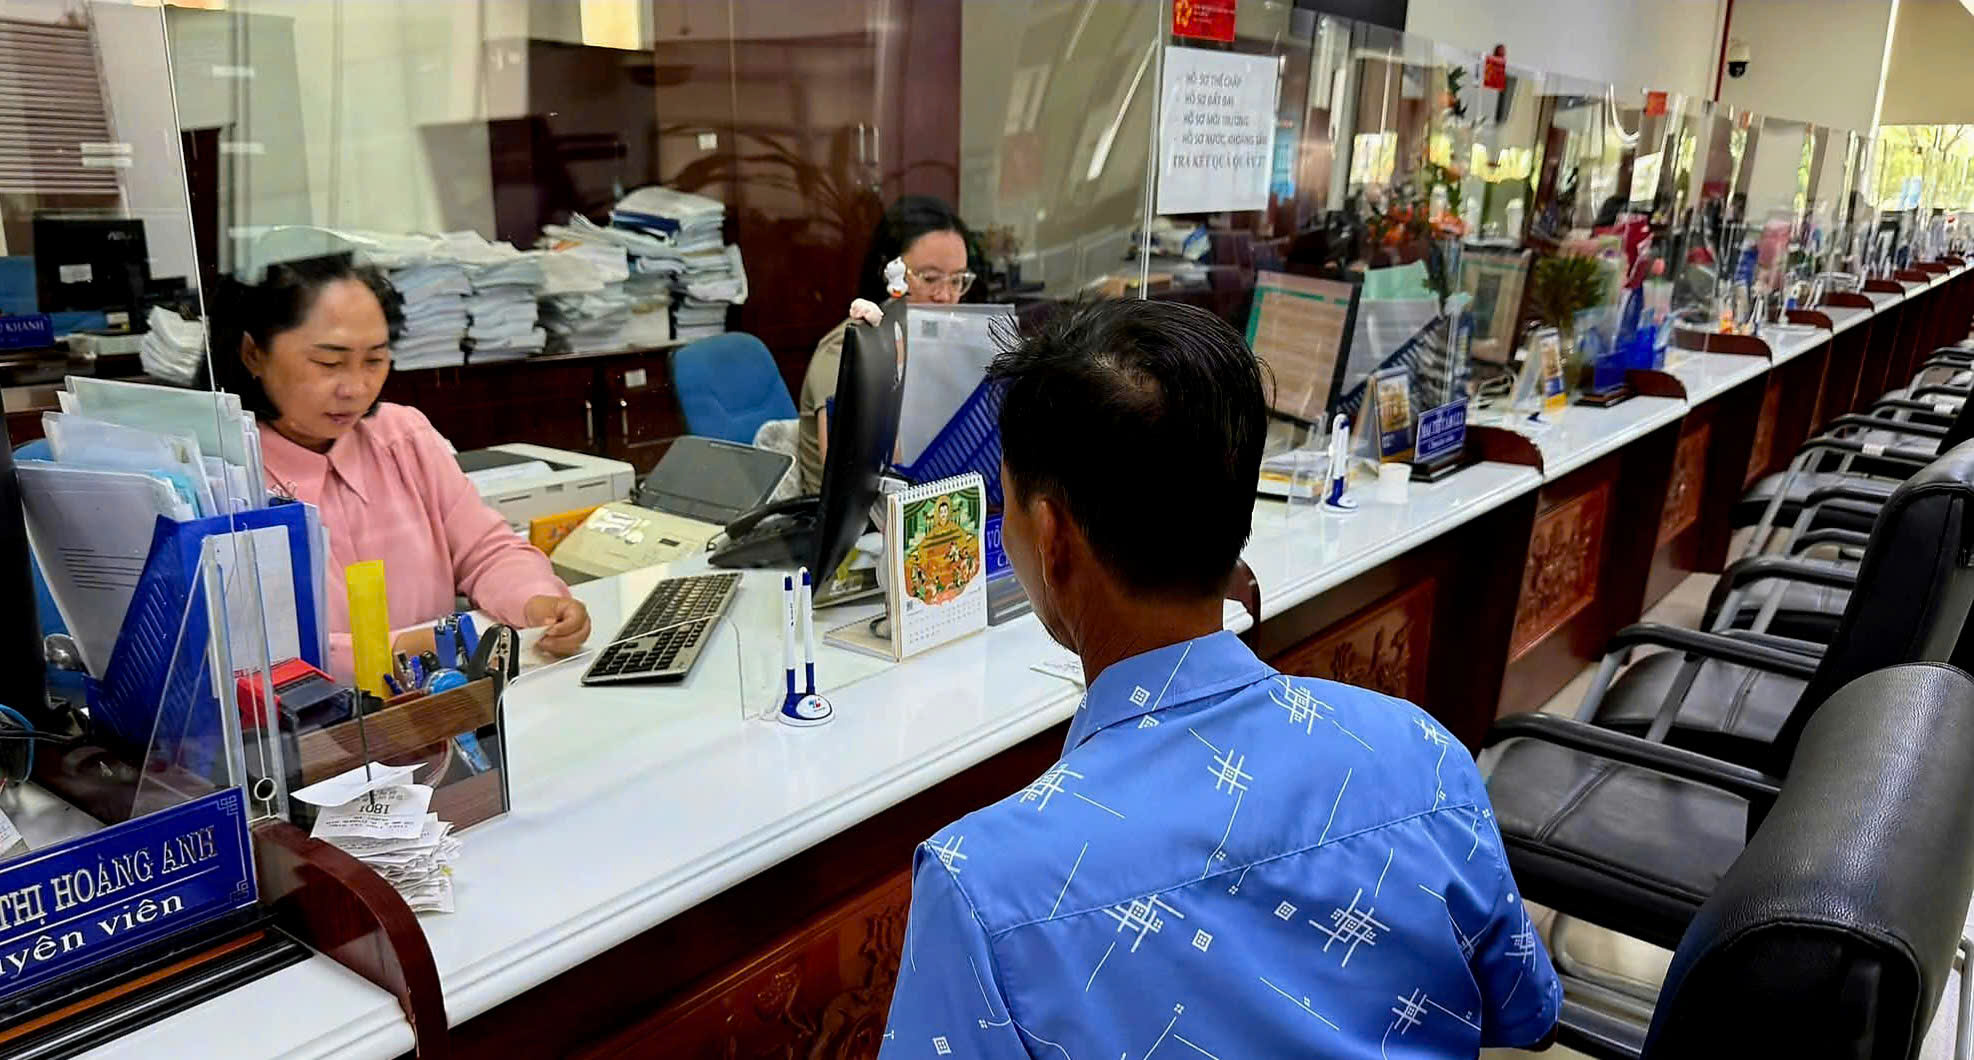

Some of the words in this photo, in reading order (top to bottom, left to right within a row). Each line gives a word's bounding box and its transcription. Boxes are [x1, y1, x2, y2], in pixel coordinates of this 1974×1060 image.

[0, 882, 48, 930] THỊ
[51, 846, 154, 913] HOÀNG
[161, 824, 220, 874] ANH
[98, 892, 185, 936] viên
